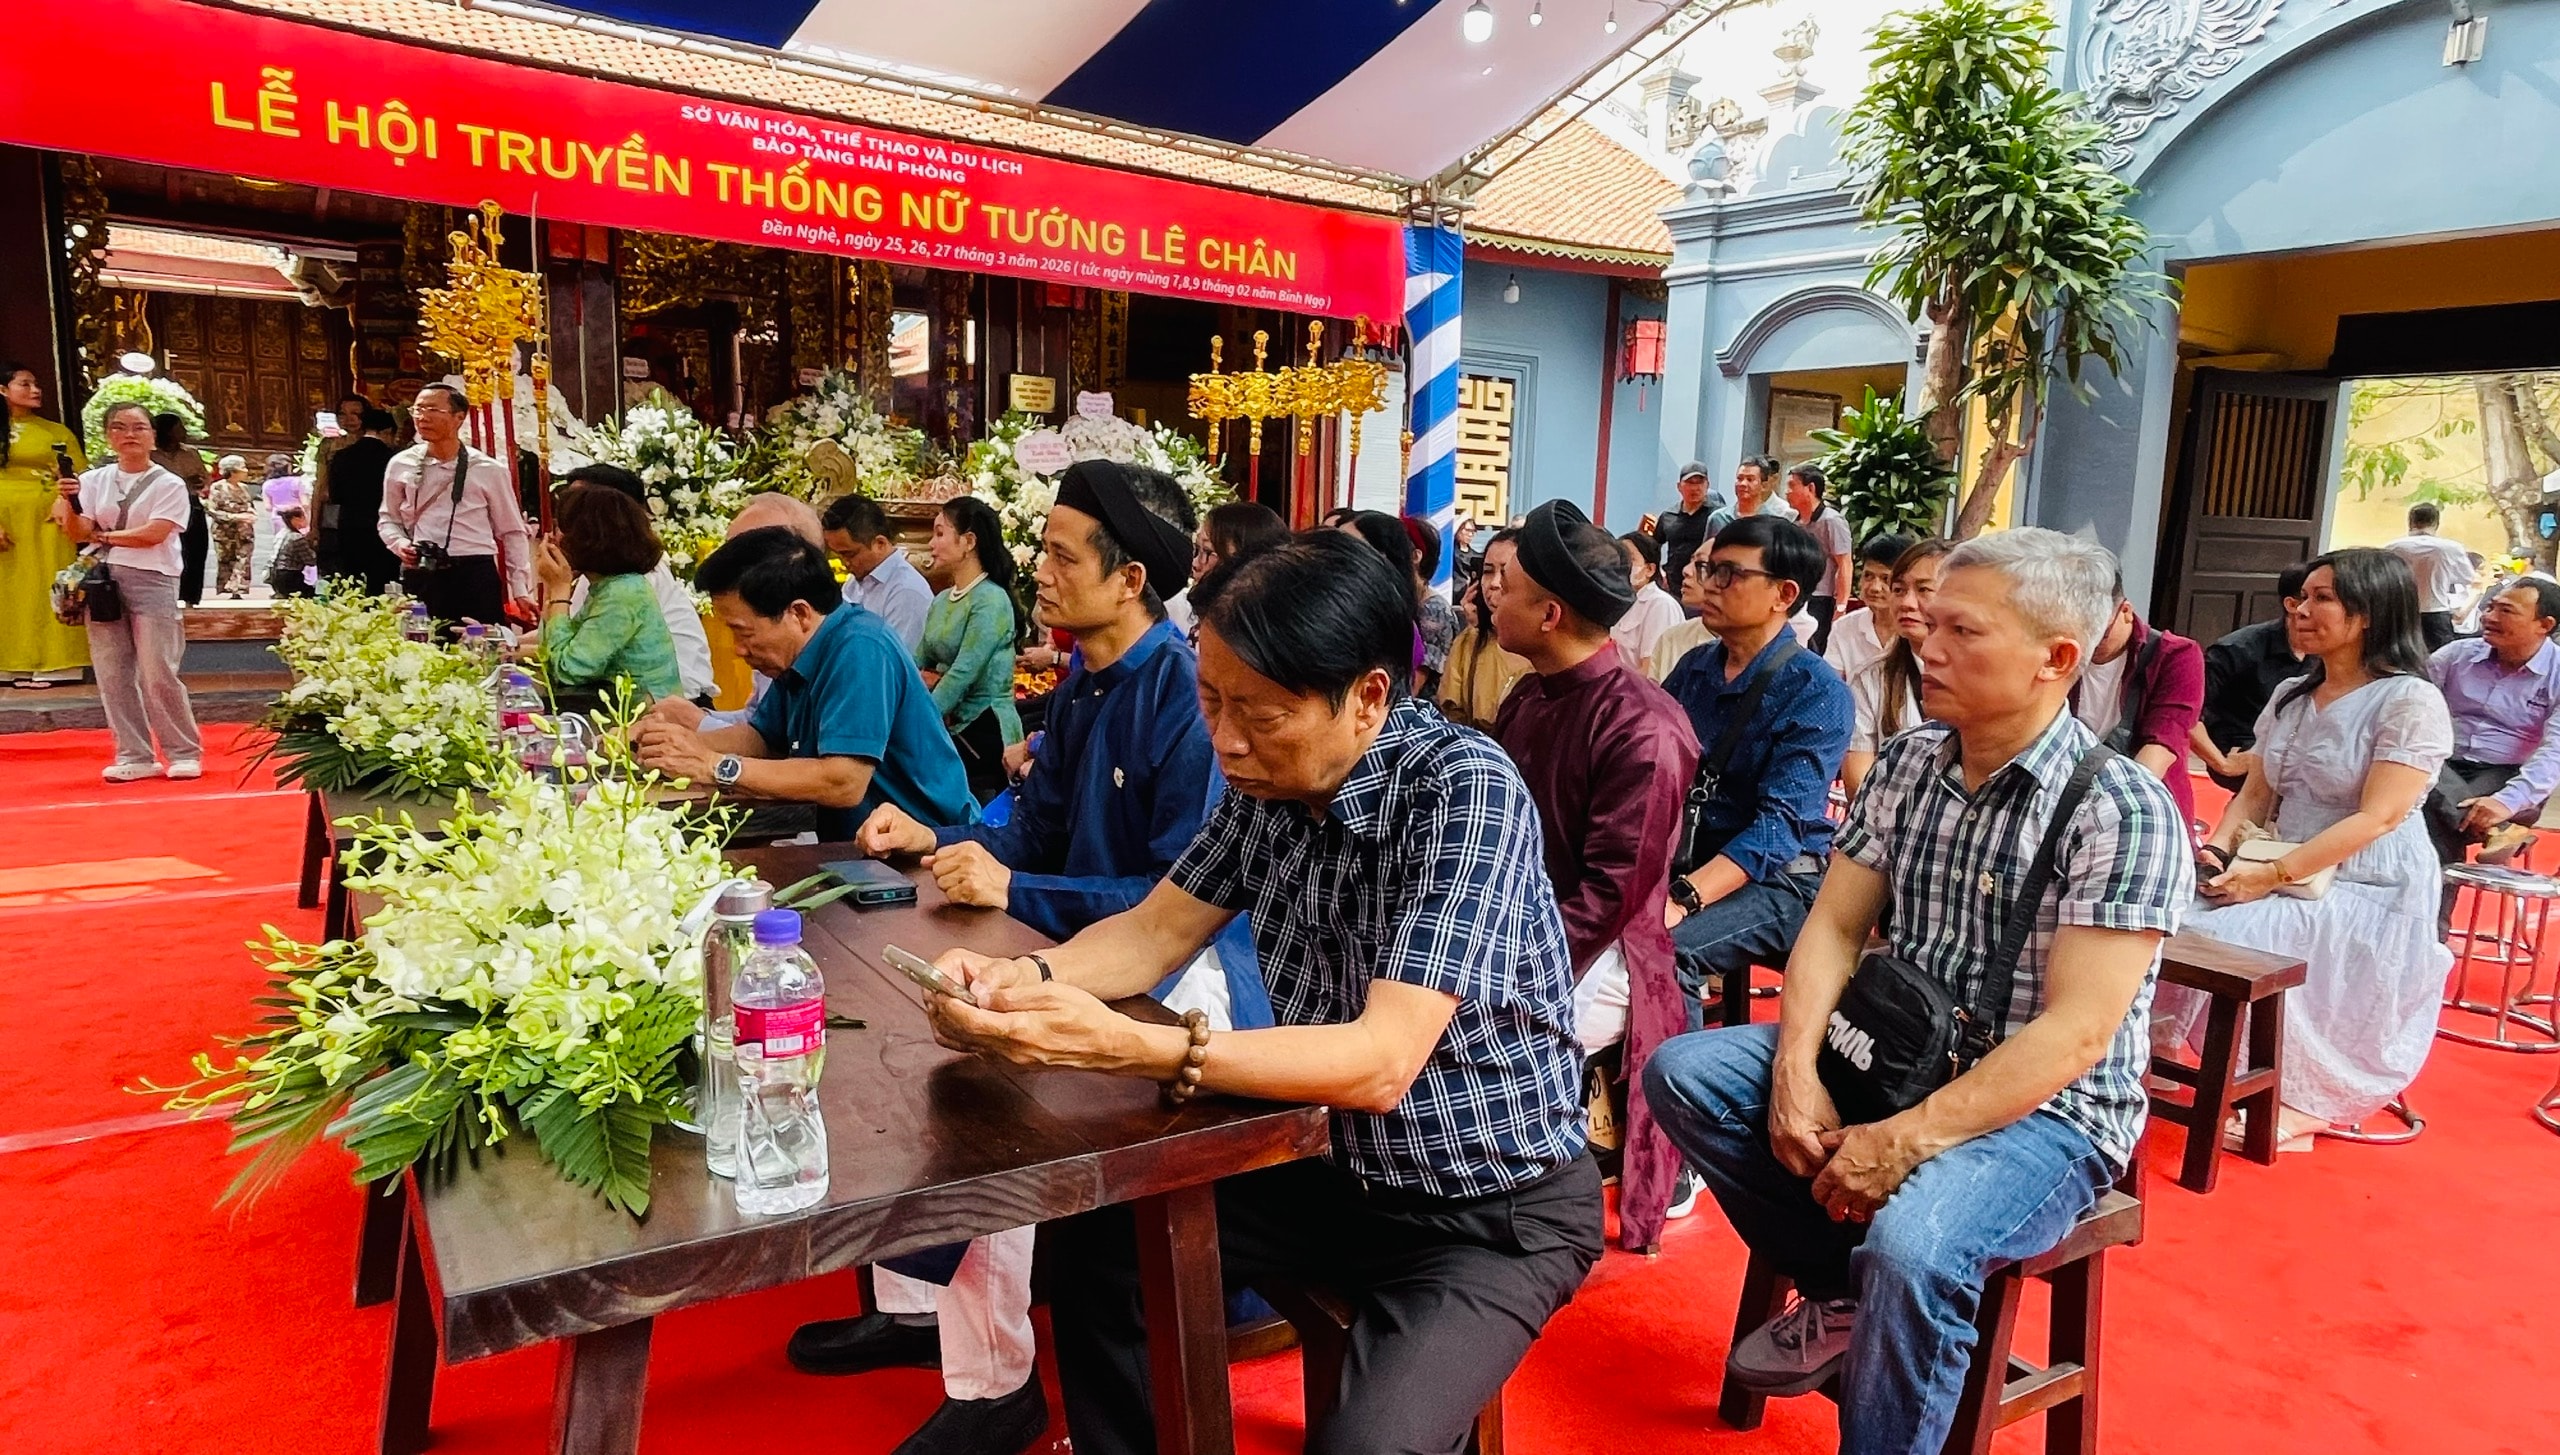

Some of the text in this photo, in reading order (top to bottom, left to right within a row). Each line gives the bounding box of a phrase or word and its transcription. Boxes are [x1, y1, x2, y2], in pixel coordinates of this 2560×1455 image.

[211, 67, 1297, 282] LỄ HỘI TRUYỀN THỐNG NỮ TƯỚNG LÊ CHÂN
[681, 105, 1023, 175] SỞ VĂN HÓA, THỂ THAO VÀ DU LỊCH
[753, 136, 966, 184] BẢO TÀNG HẢI PHÒNG
[761, 218, 793, 237] Đền
[797, 224, 841, 247] Nghè,
[844, 231, 882, 252] ngày
[884, 236, 906, 255] 25,
[909, 240, 931, 258] 26,
[934, 243, 952, 258] 27
[954, 246, 995, 267] tháng
[997, 251, 1006, 265] 3
[1008, 253, 1038, 269] năm
[1040, 257, 1072, 273] 2026
[1081, 261, 1101, 277] tức
[1103, 267, 1135, 285] ngày
[1136, 270, 1170, 289] mùng
[1172, 273, 1200, 291] 7,8,9
[1202, 278, 1235, 298] tháng
[1237, 284, 1251, 297] 02
[1252, 286, 1277, 300] năm
[1304, 293, 1326, 310] Ngọ
